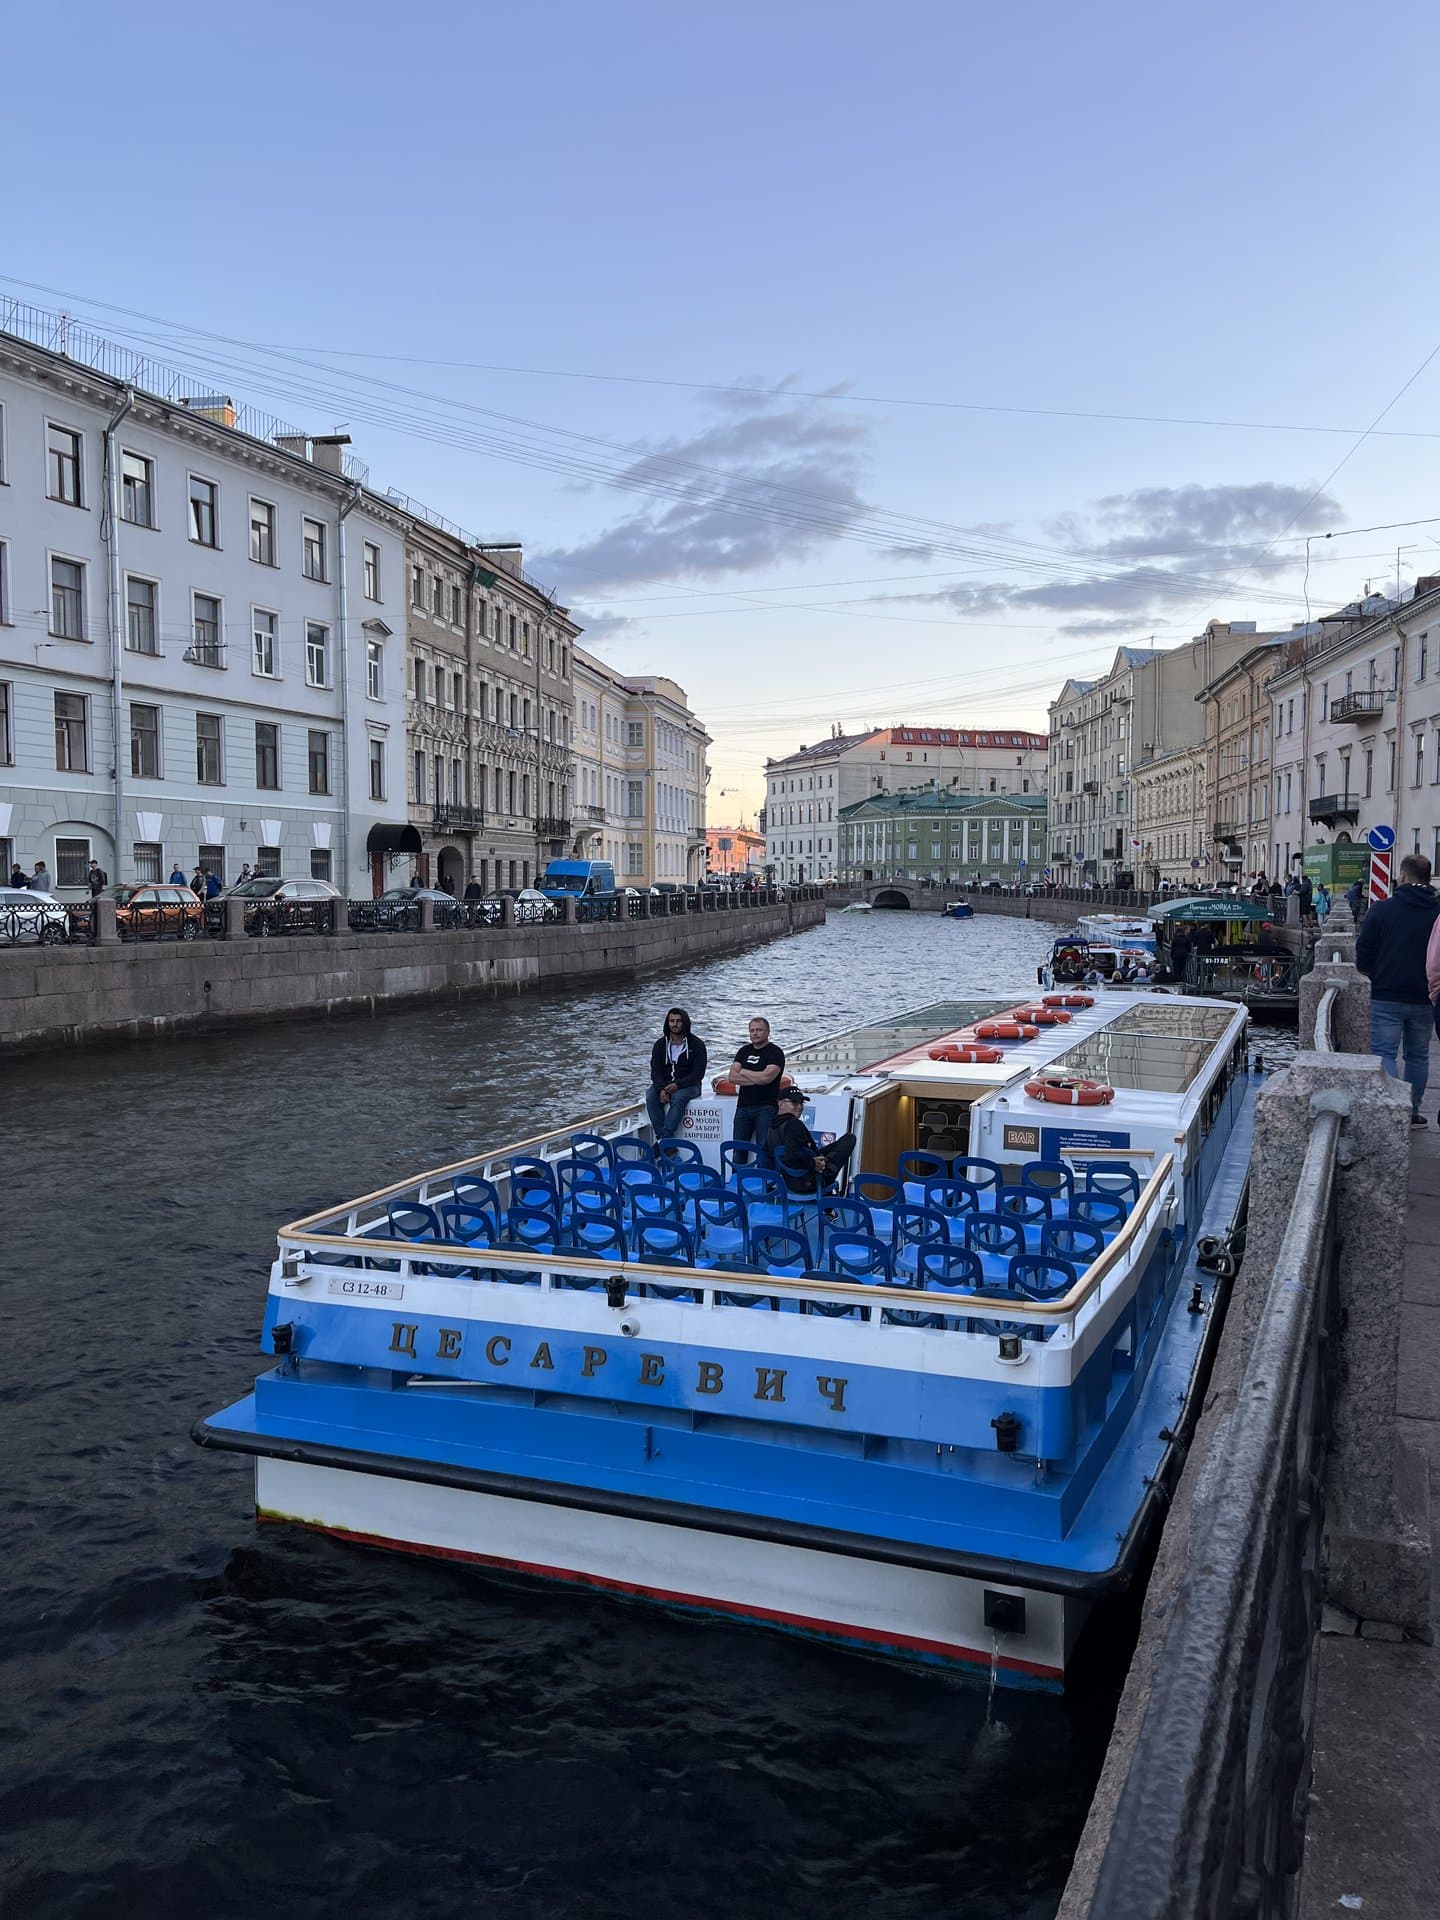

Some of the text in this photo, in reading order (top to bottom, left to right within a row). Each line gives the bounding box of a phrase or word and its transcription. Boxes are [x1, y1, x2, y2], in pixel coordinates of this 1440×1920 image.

[683, 1109, 720, 1117] ВЫБРОС
[695, 1117, 720, 1125] МУСОРА
[1007, 1130, 1035, 1145] BAR
[357, 1283, 388, 1296] 12-48
[388, 1322, 848, 1412] ЦЕСАРЕВИЧ
